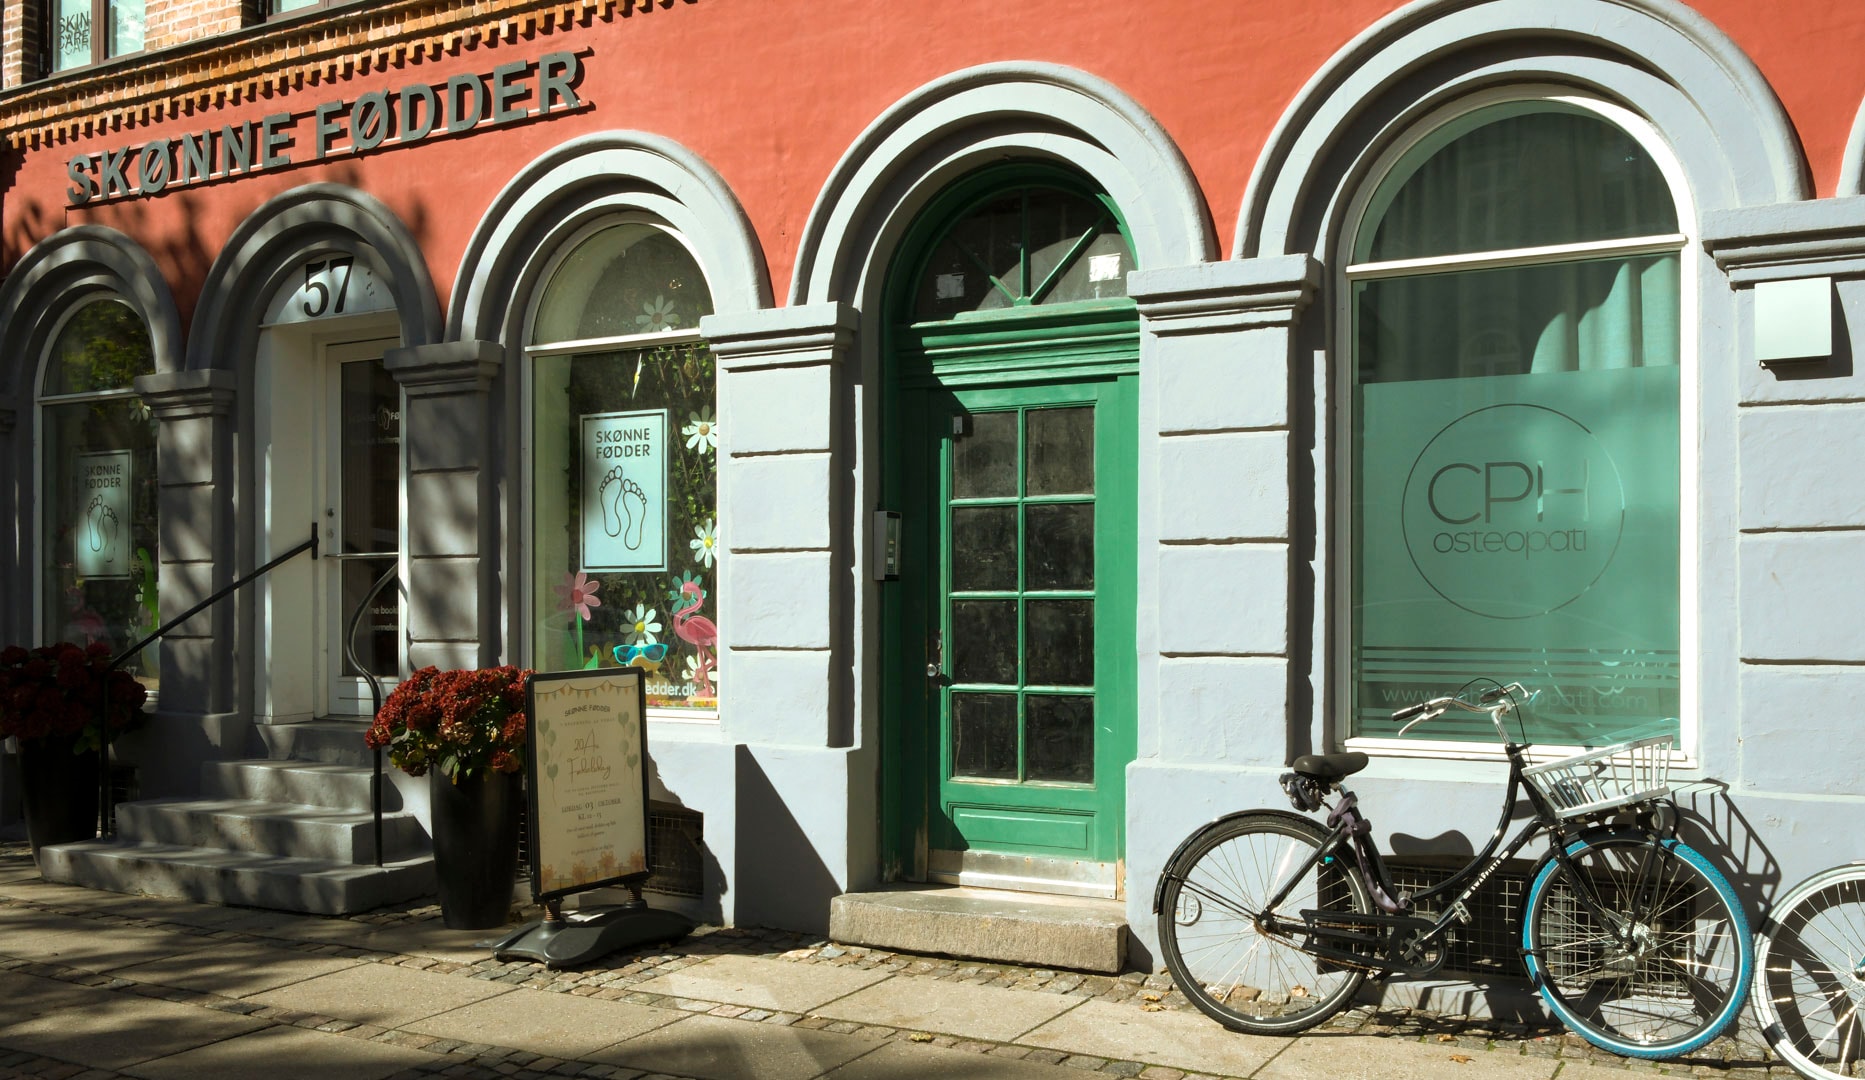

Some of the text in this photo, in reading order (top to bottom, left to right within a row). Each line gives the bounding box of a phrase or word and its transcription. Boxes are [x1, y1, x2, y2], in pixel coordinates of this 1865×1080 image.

[58, 11, 90, 34] SKIN
[58, 29, 90, 50] CARE
[66, 51, 585, 205] SKØNNE FØDDER
[303, 256, 355, 318] 57
[595, 427, 651, 444] SKØNNE
[595, 444, 651, 460] FØDDER
[85, 464, 121, 477] SKØNNE
[85, 477, 121, 489] FØDDER
[1428, 459, 1590, 525] CPH
[1433, 528, 1587, 560] osteopati
[1470, 859, 1502, 892] SWAPFIETS
